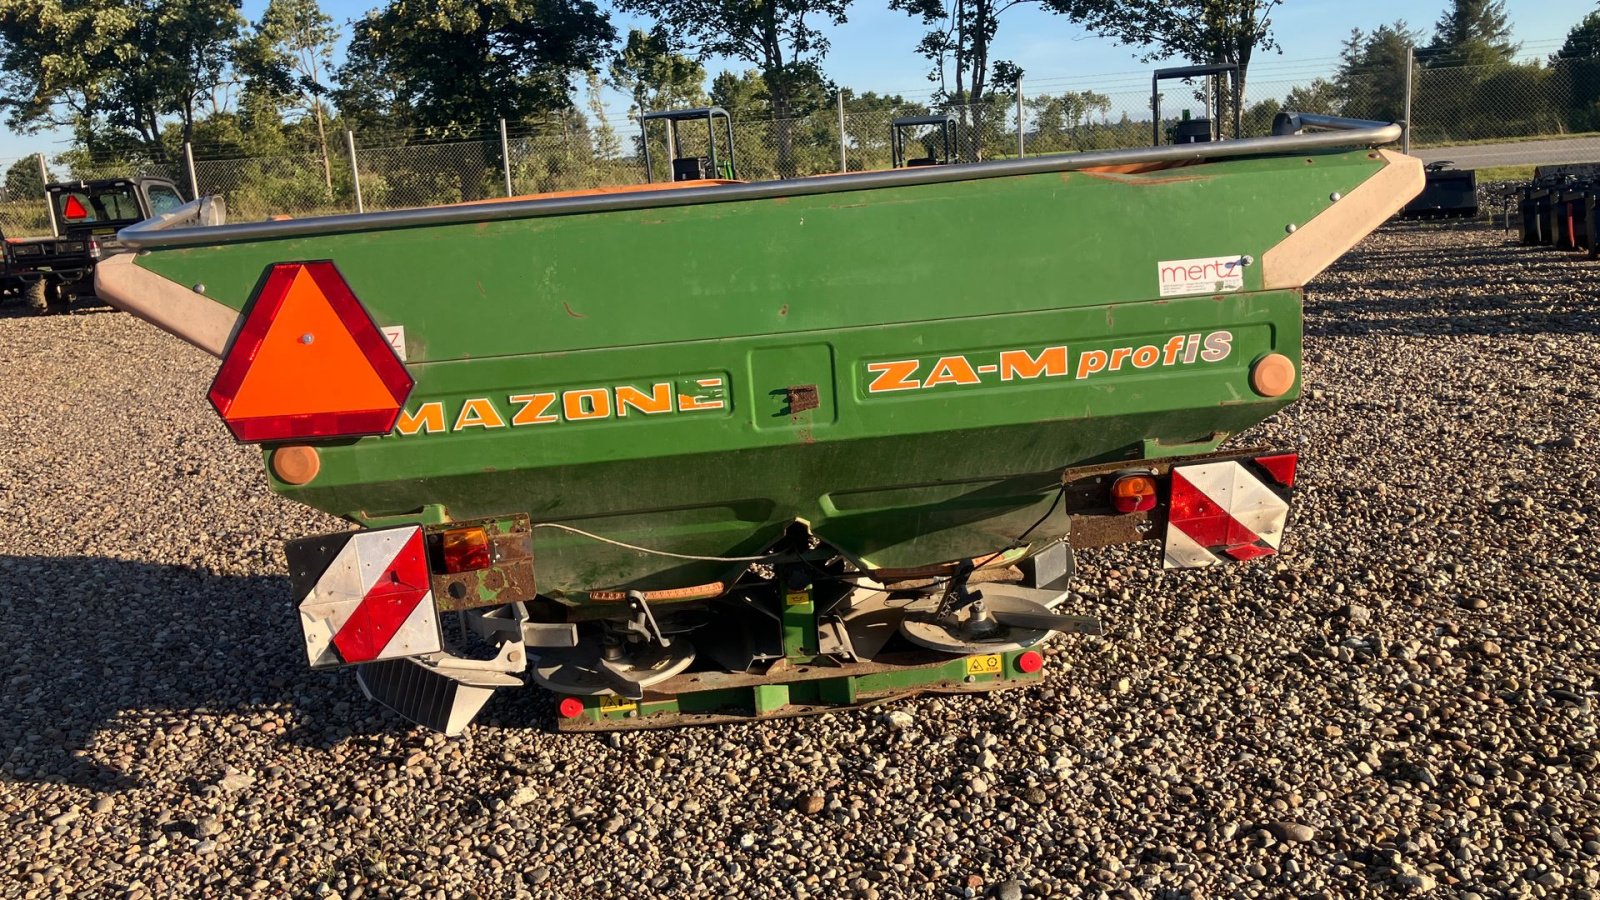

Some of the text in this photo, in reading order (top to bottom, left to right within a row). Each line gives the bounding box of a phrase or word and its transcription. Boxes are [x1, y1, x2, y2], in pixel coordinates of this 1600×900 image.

[1162, 260, 1239, 282] mertz
[867, 346, 1068, 393] ZA-M
[362, 378, 724, 437] MAZONE
